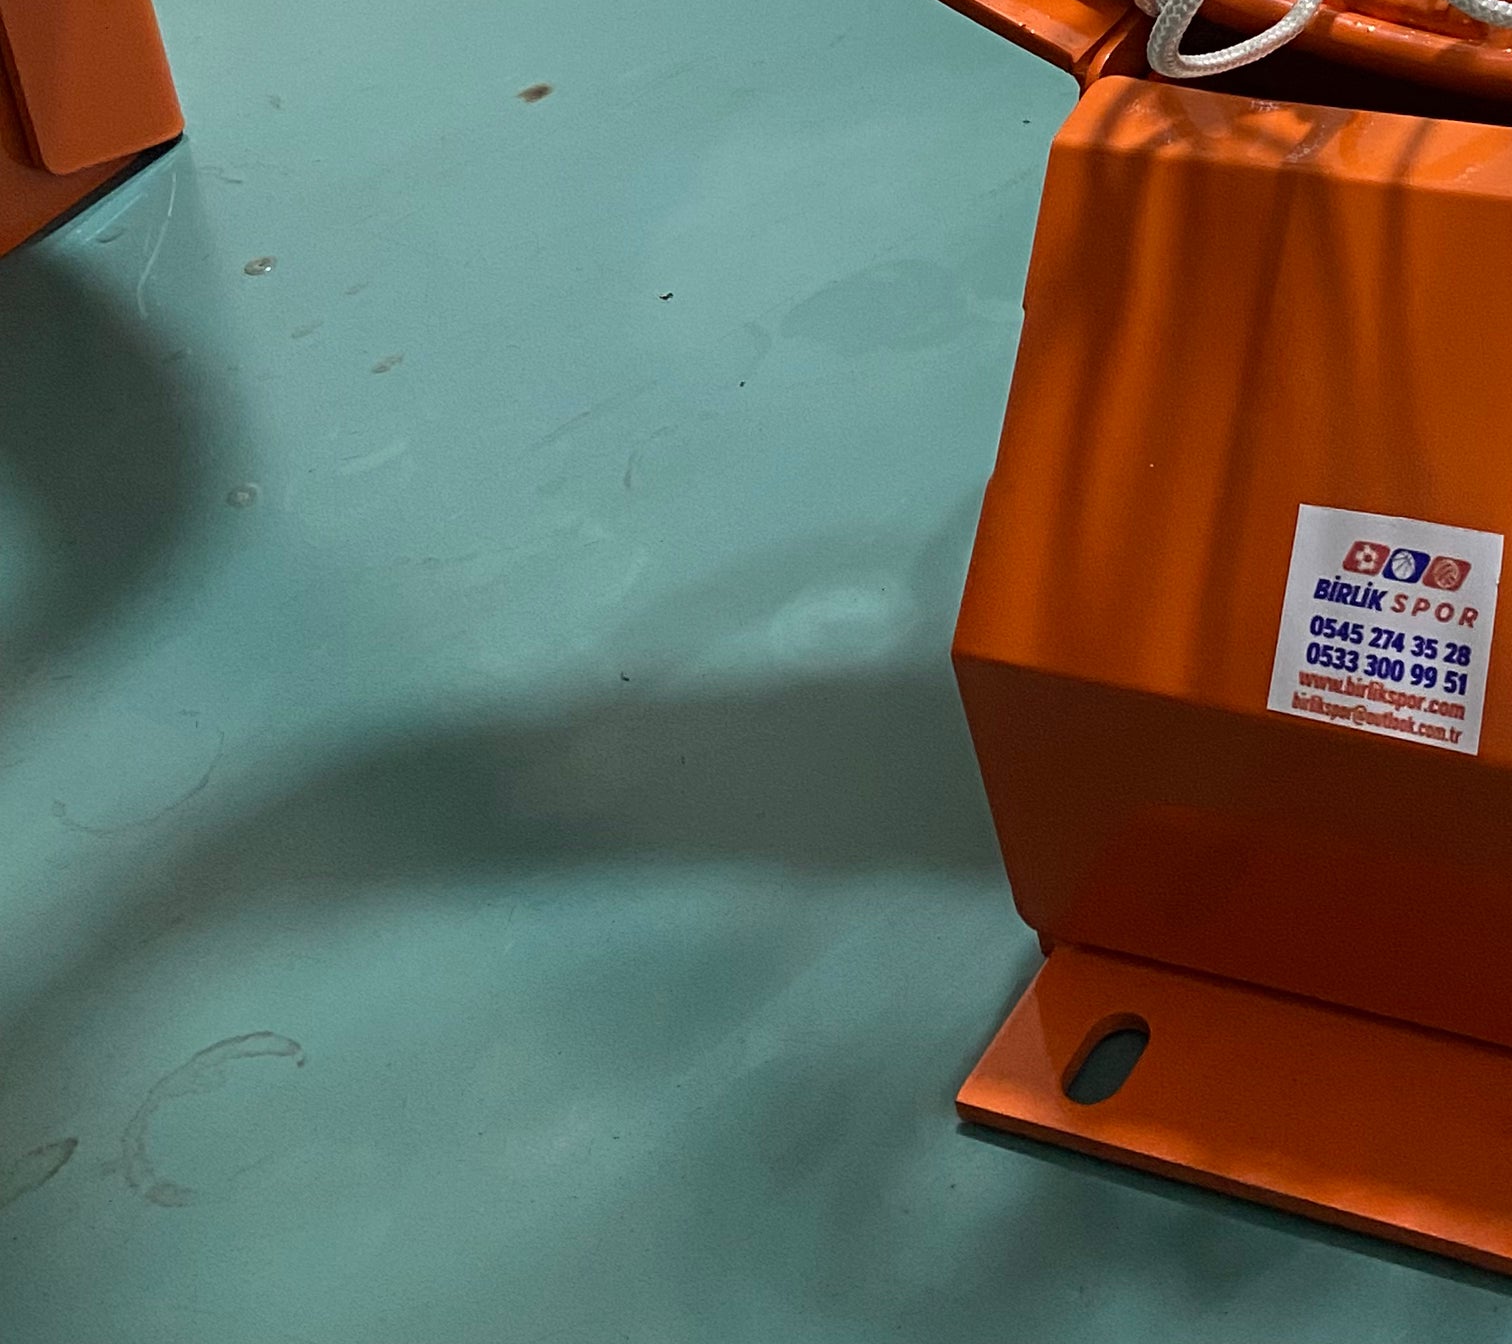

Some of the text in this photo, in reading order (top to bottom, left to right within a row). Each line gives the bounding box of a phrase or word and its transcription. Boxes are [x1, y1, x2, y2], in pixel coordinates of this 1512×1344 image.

[1313, 575, 1479, 629] BİRLİK SPOR
[1309, 615, 1472, 667] 0545 274 35 28
[1299, 670, 1466, 721] www.birlikspor.com
[1306, 642, 1468, 696] 0533 300 99 51
[1291, 691, 1463, 745] birlikspor@outlook.com.tr
